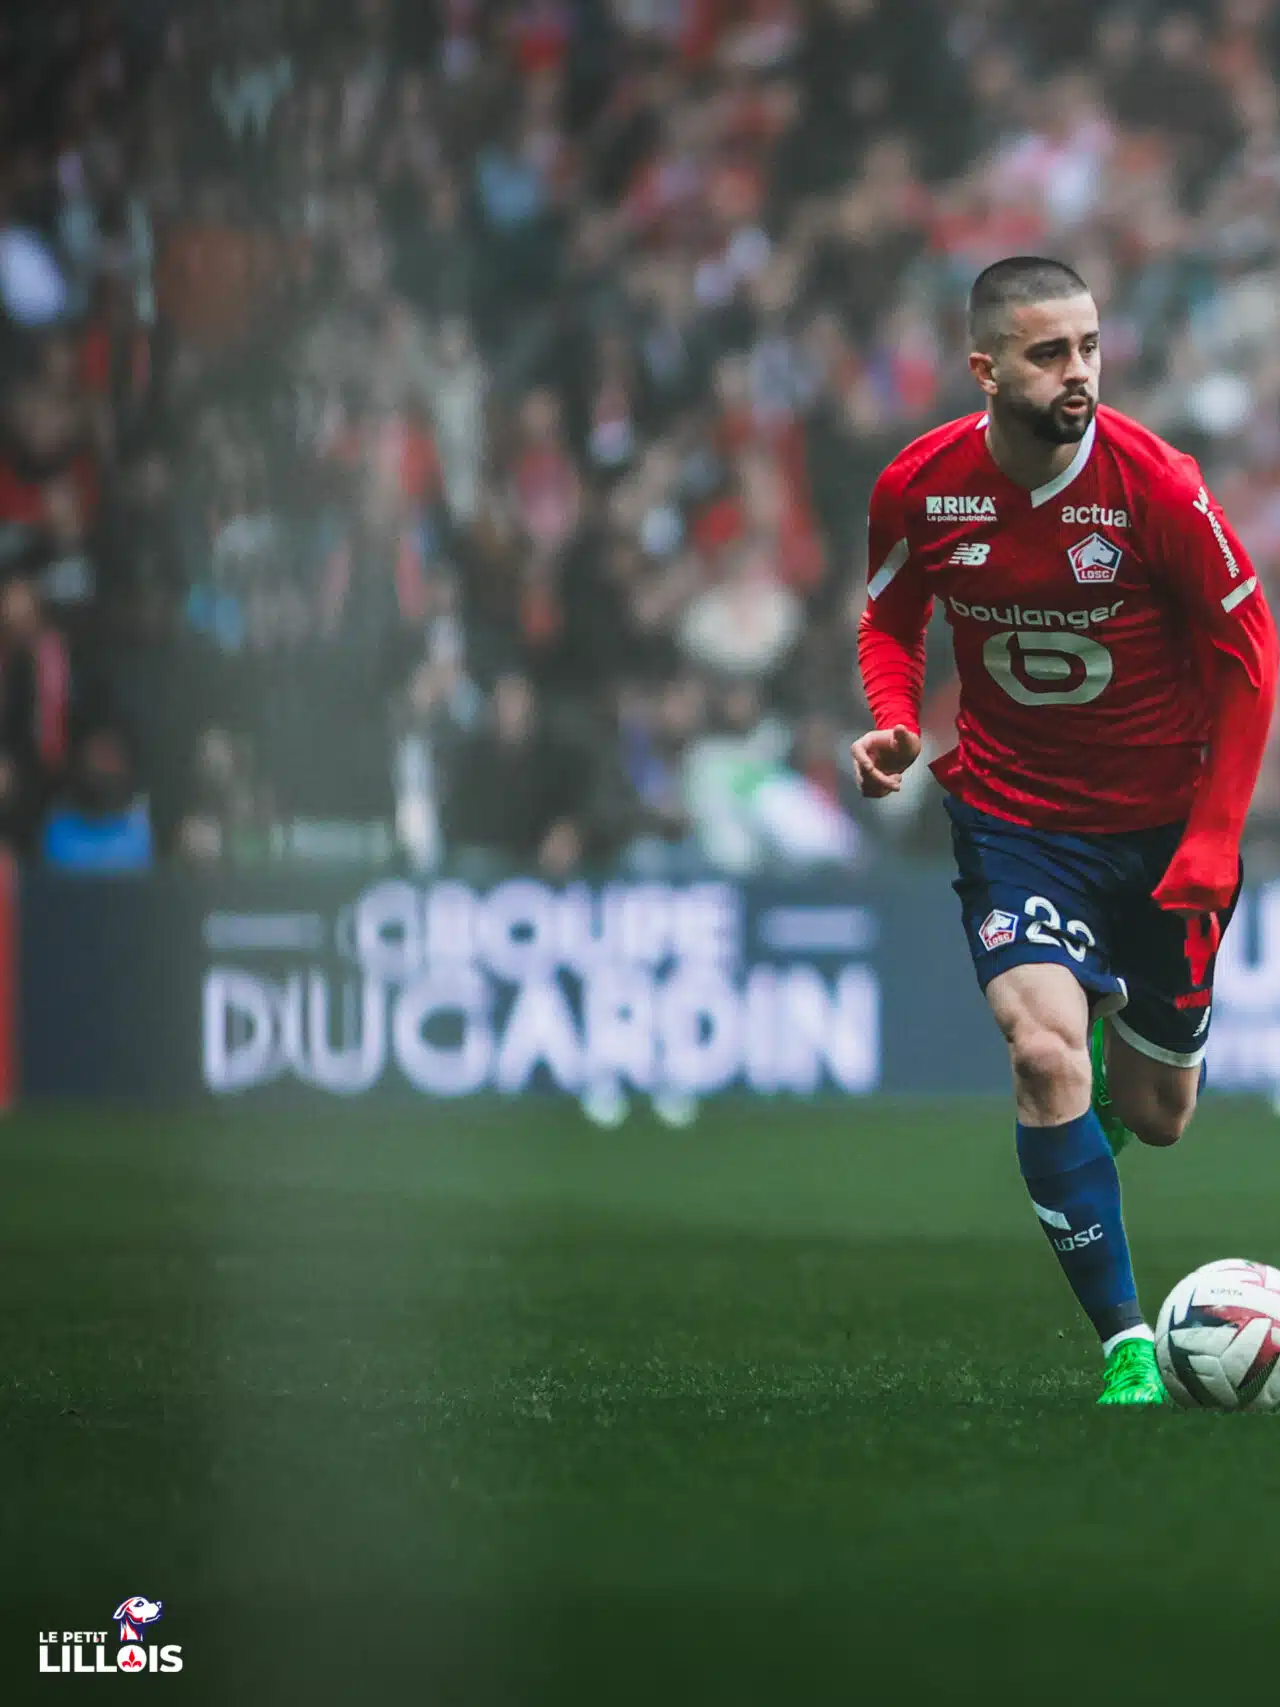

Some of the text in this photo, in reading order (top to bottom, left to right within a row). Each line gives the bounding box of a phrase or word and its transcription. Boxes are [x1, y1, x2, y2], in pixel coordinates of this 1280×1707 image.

[943, 496, 996, 514] RIKA
[1080, 570, 1110, 579] LOSC
[948, 595, 1125, 630] boulanger
[202, 968, 880, 1094] DUGARDIN
[1053, 1223, 1104, 1252] LOSC
